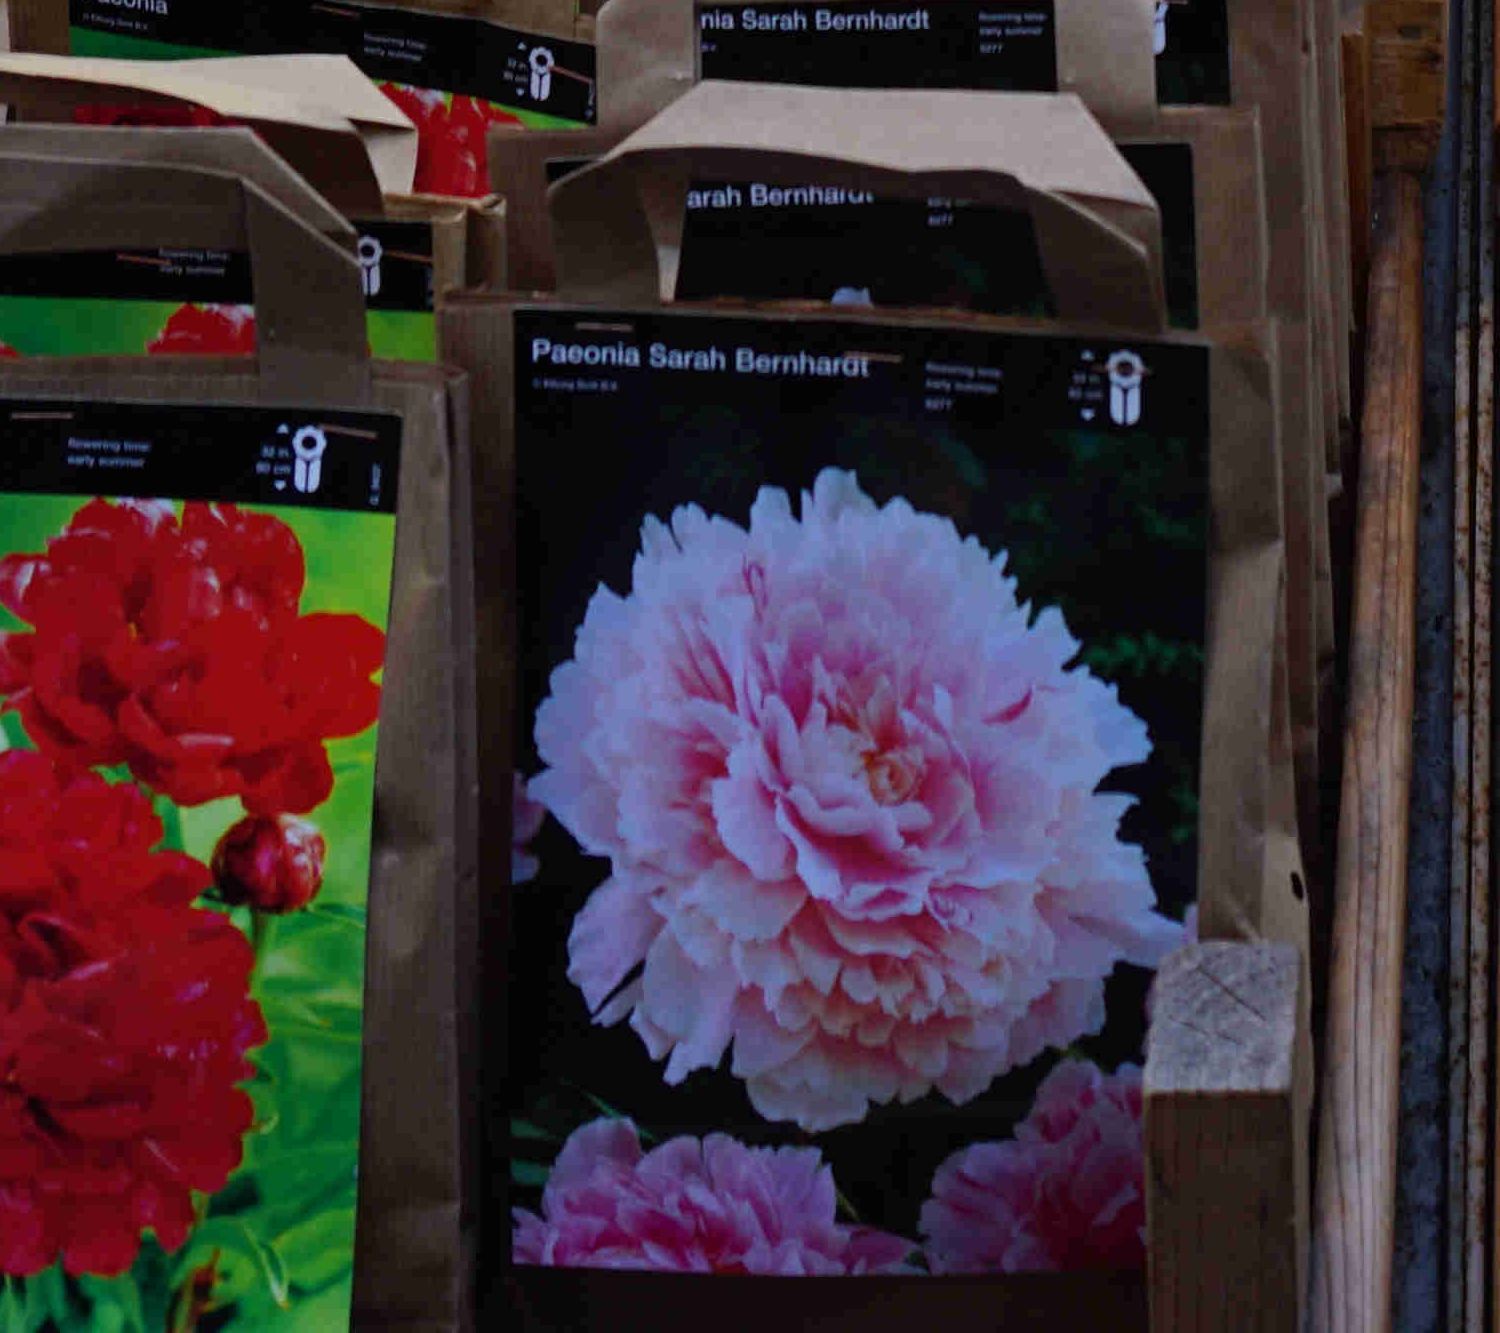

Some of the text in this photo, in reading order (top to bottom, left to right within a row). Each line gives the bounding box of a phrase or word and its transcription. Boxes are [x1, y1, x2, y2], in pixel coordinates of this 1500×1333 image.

[741, 8, 808, 31] Sarah
[813, 8, 931, 32] Bernhardt
[687, 184, 743, 211] arah
[531, 337, 871, 379] Paeonia Sarah Bernhardt
